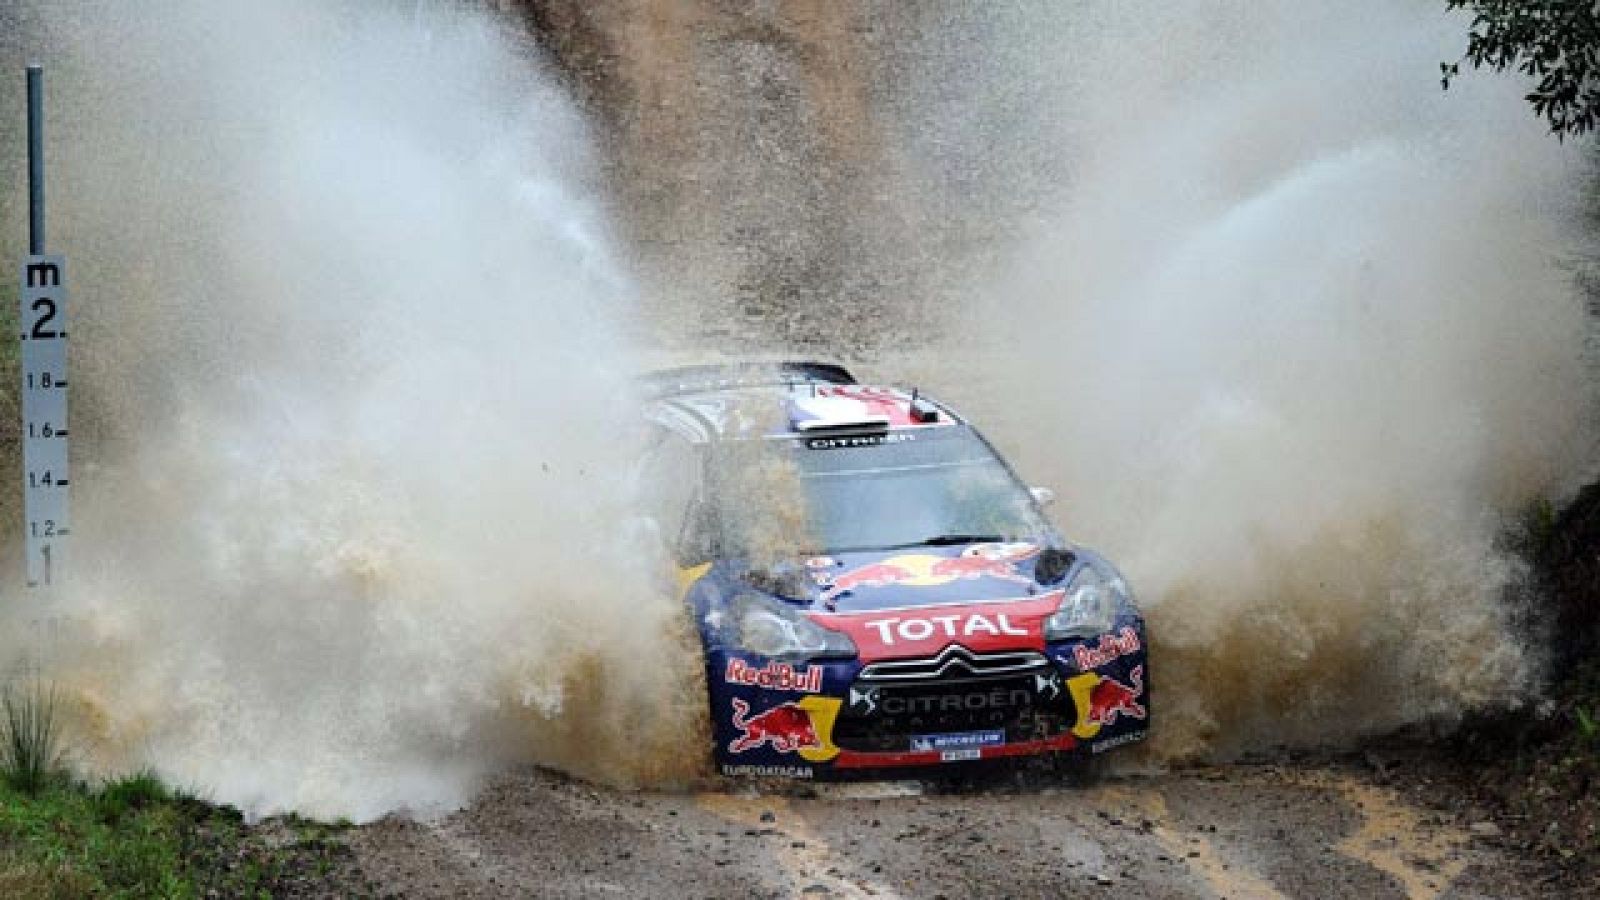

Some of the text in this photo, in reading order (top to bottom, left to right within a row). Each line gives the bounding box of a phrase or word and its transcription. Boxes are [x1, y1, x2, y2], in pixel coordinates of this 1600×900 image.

[27, 263, 61, 288] m
[31, 297, 57, 340] 2
[29, 421, 53, 438] 1.6
[29, 470, 52, 488] 1.4
[32, 519, 55, 538] 1.2
[865, 612, 1029, 646] TOTAL
[725, 657, 823, 693] Red Bull
